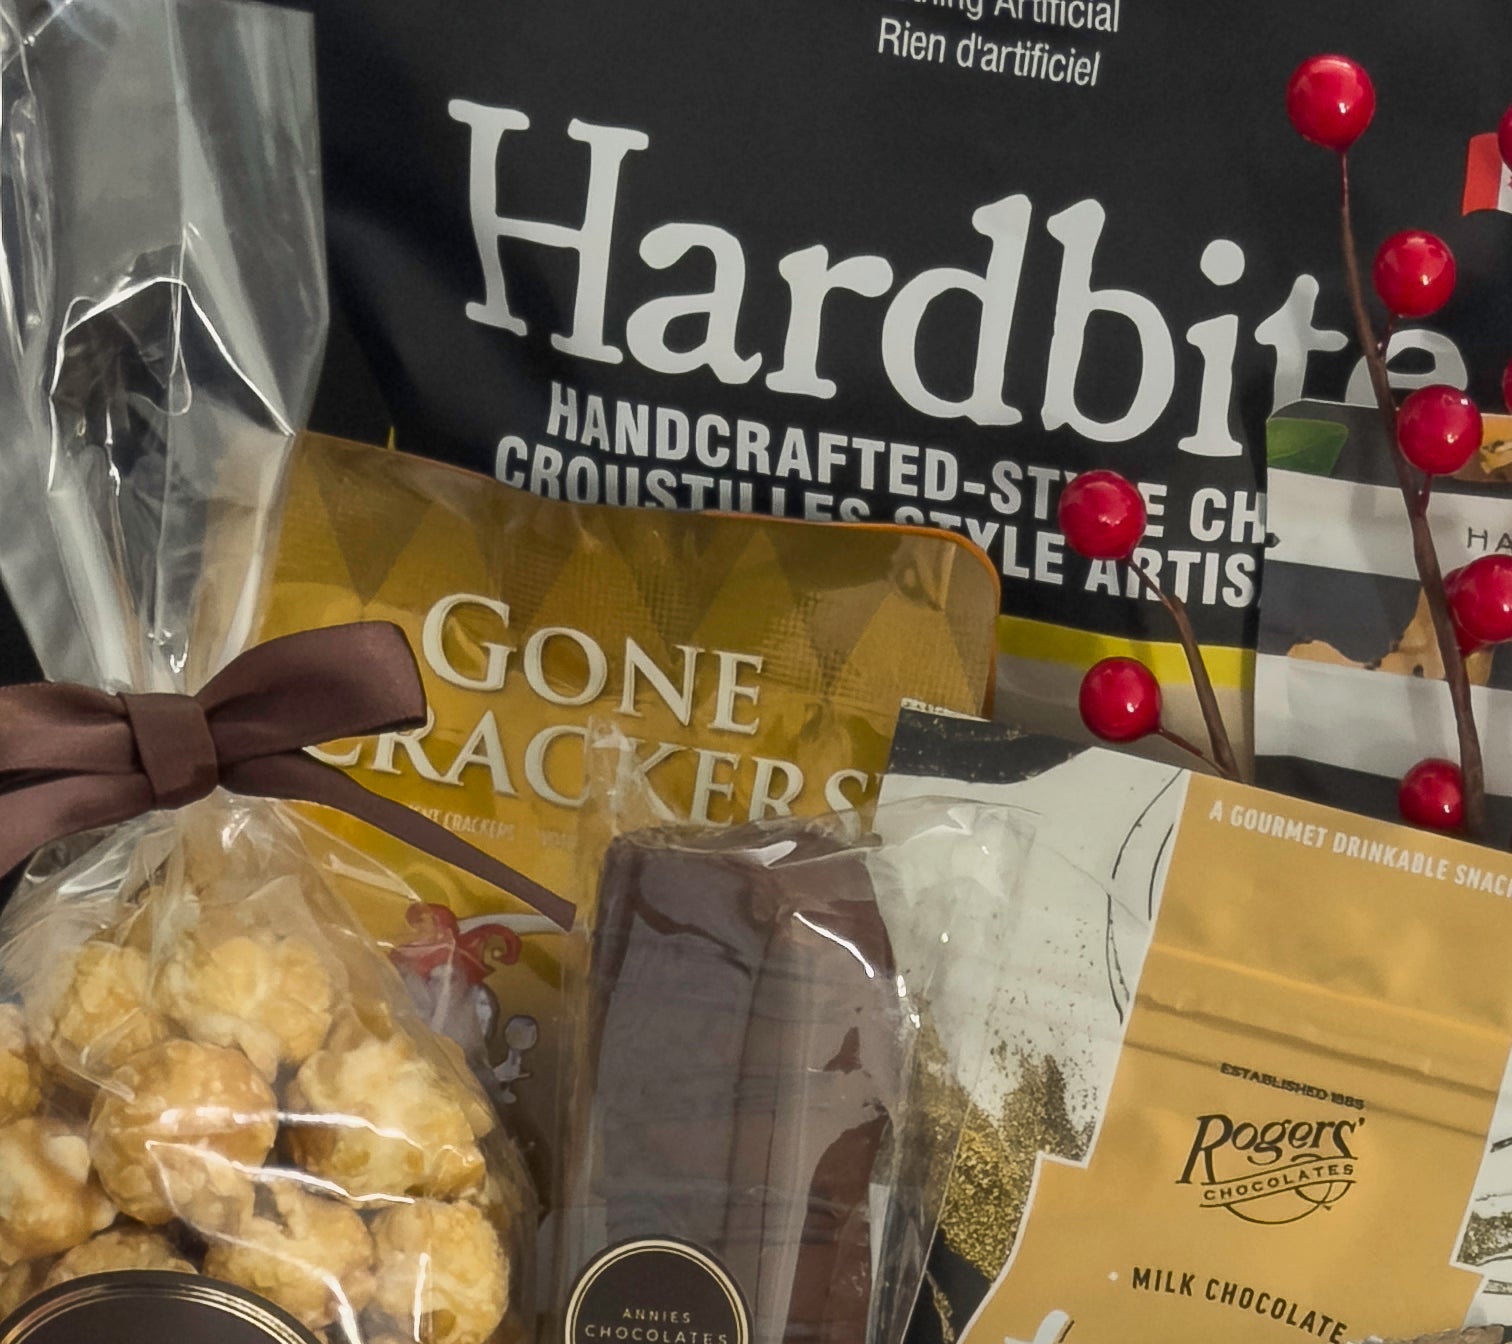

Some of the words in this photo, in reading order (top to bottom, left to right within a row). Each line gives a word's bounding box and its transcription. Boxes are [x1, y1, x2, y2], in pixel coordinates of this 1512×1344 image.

[878, 17, 946, 63] Rien
[956, 32, 1101, 86] d'artificiel
[546, 382, 1167, 537] HANDCRAFTED-STE
[894, 506, 1065, 584] YLE
[421, 593, 764, 736] GONE
[1209, 800, 1222, 822] A
[1230, 805, 1328, 848] GOURMET
[1332, 832, 1449, 881] DRINKABLE
[1220, 1062, 1328, 1101] ESTABLISHED
[1203, 1164, 1354, 1201] CHOCOLATES
[622, 1308, 691, 1323] ANNIES
[1132, 1267, 1195, 1297] MILK
[1205, 1278, 1348, 1344] CHOCOLATE
